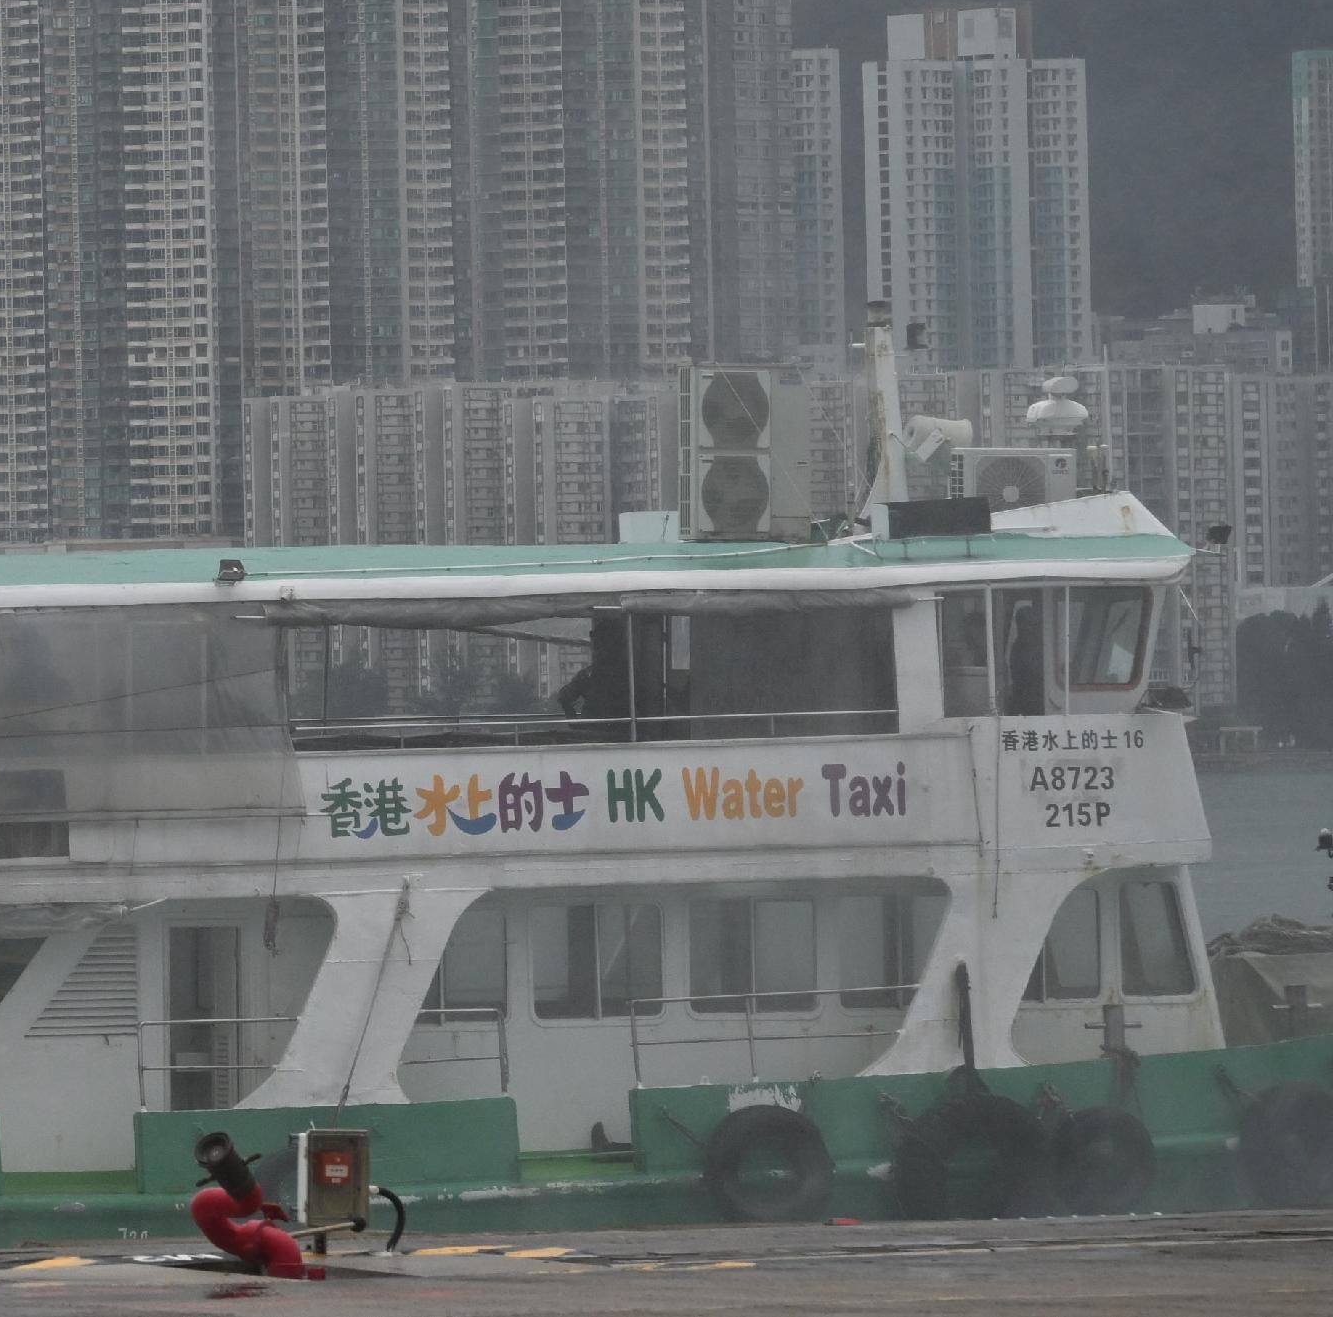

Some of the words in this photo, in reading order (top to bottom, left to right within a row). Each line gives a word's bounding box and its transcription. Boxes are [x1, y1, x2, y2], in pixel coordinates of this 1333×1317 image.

[1029, 766, 1115, 791] A8723
[320, 770, 590, 840] 香港水上的士
[606, 768, 665, 823] HK
[682, 766, 805, 821] Water
[821, 761, 908, 817] Taxi
[1045, 802, 1111, 827] 215P
